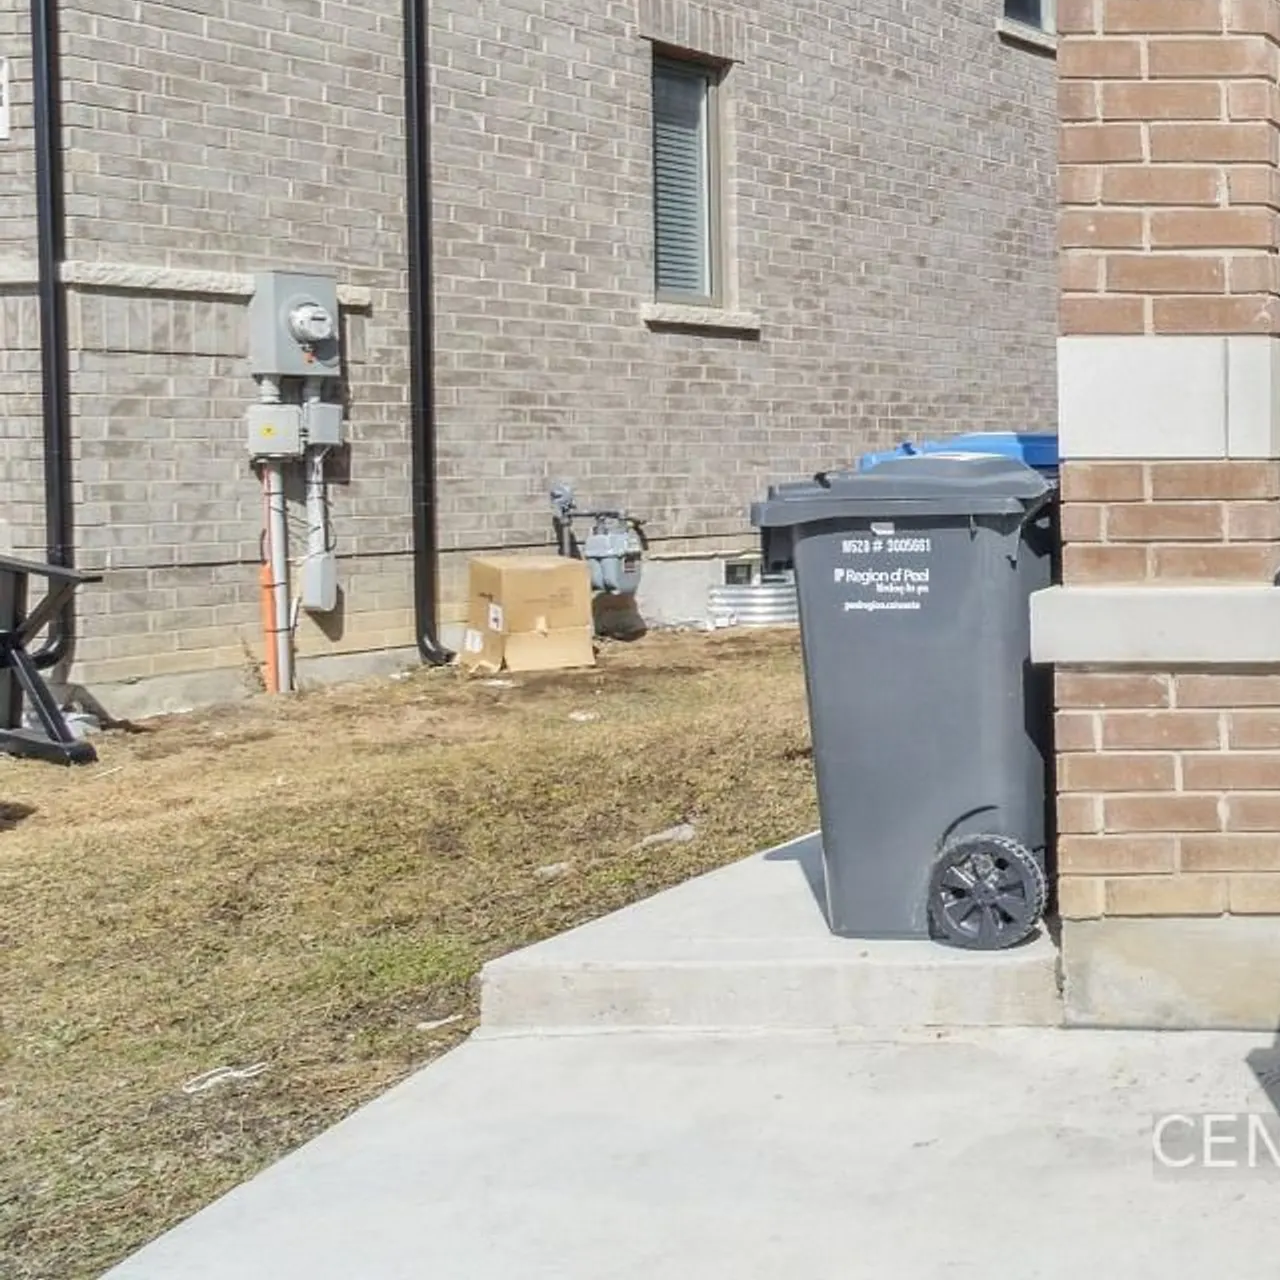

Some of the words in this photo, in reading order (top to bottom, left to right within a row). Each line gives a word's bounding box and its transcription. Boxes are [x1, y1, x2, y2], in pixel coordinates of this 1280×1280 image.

[846, 568, 889, 585] Region
[890, 568, 902, 581] of
[904, 568, 929, 582] Peel
